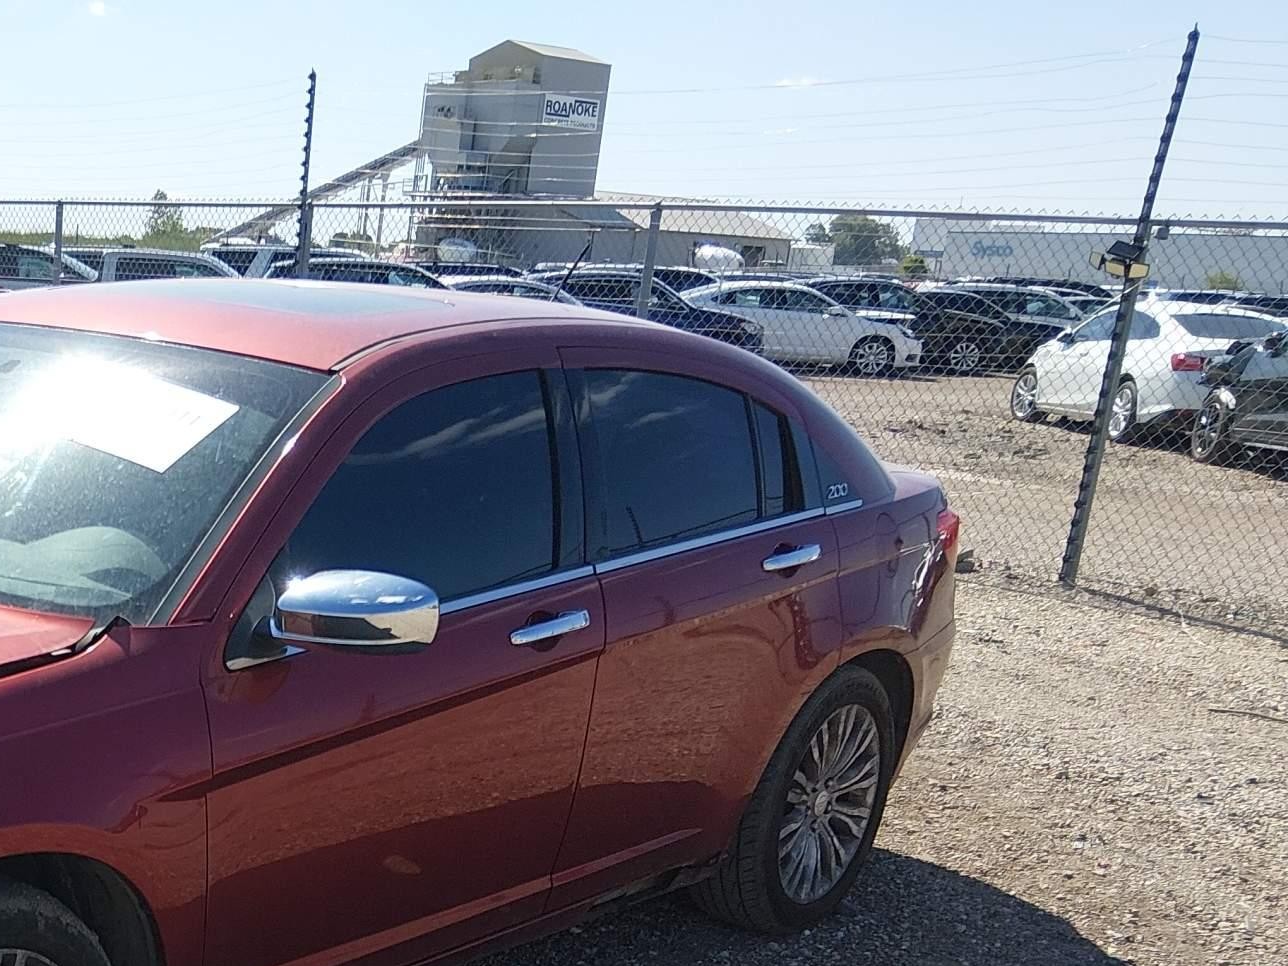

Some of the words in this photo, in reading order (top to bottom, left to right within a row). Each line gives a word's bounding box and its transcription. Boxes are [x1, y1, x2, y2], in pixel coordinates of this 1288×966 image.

[545, 100, 598, 118] ROANOKE
[972, 241, 1013, 259] Sysco
[827, 483, 848, 499] 200
